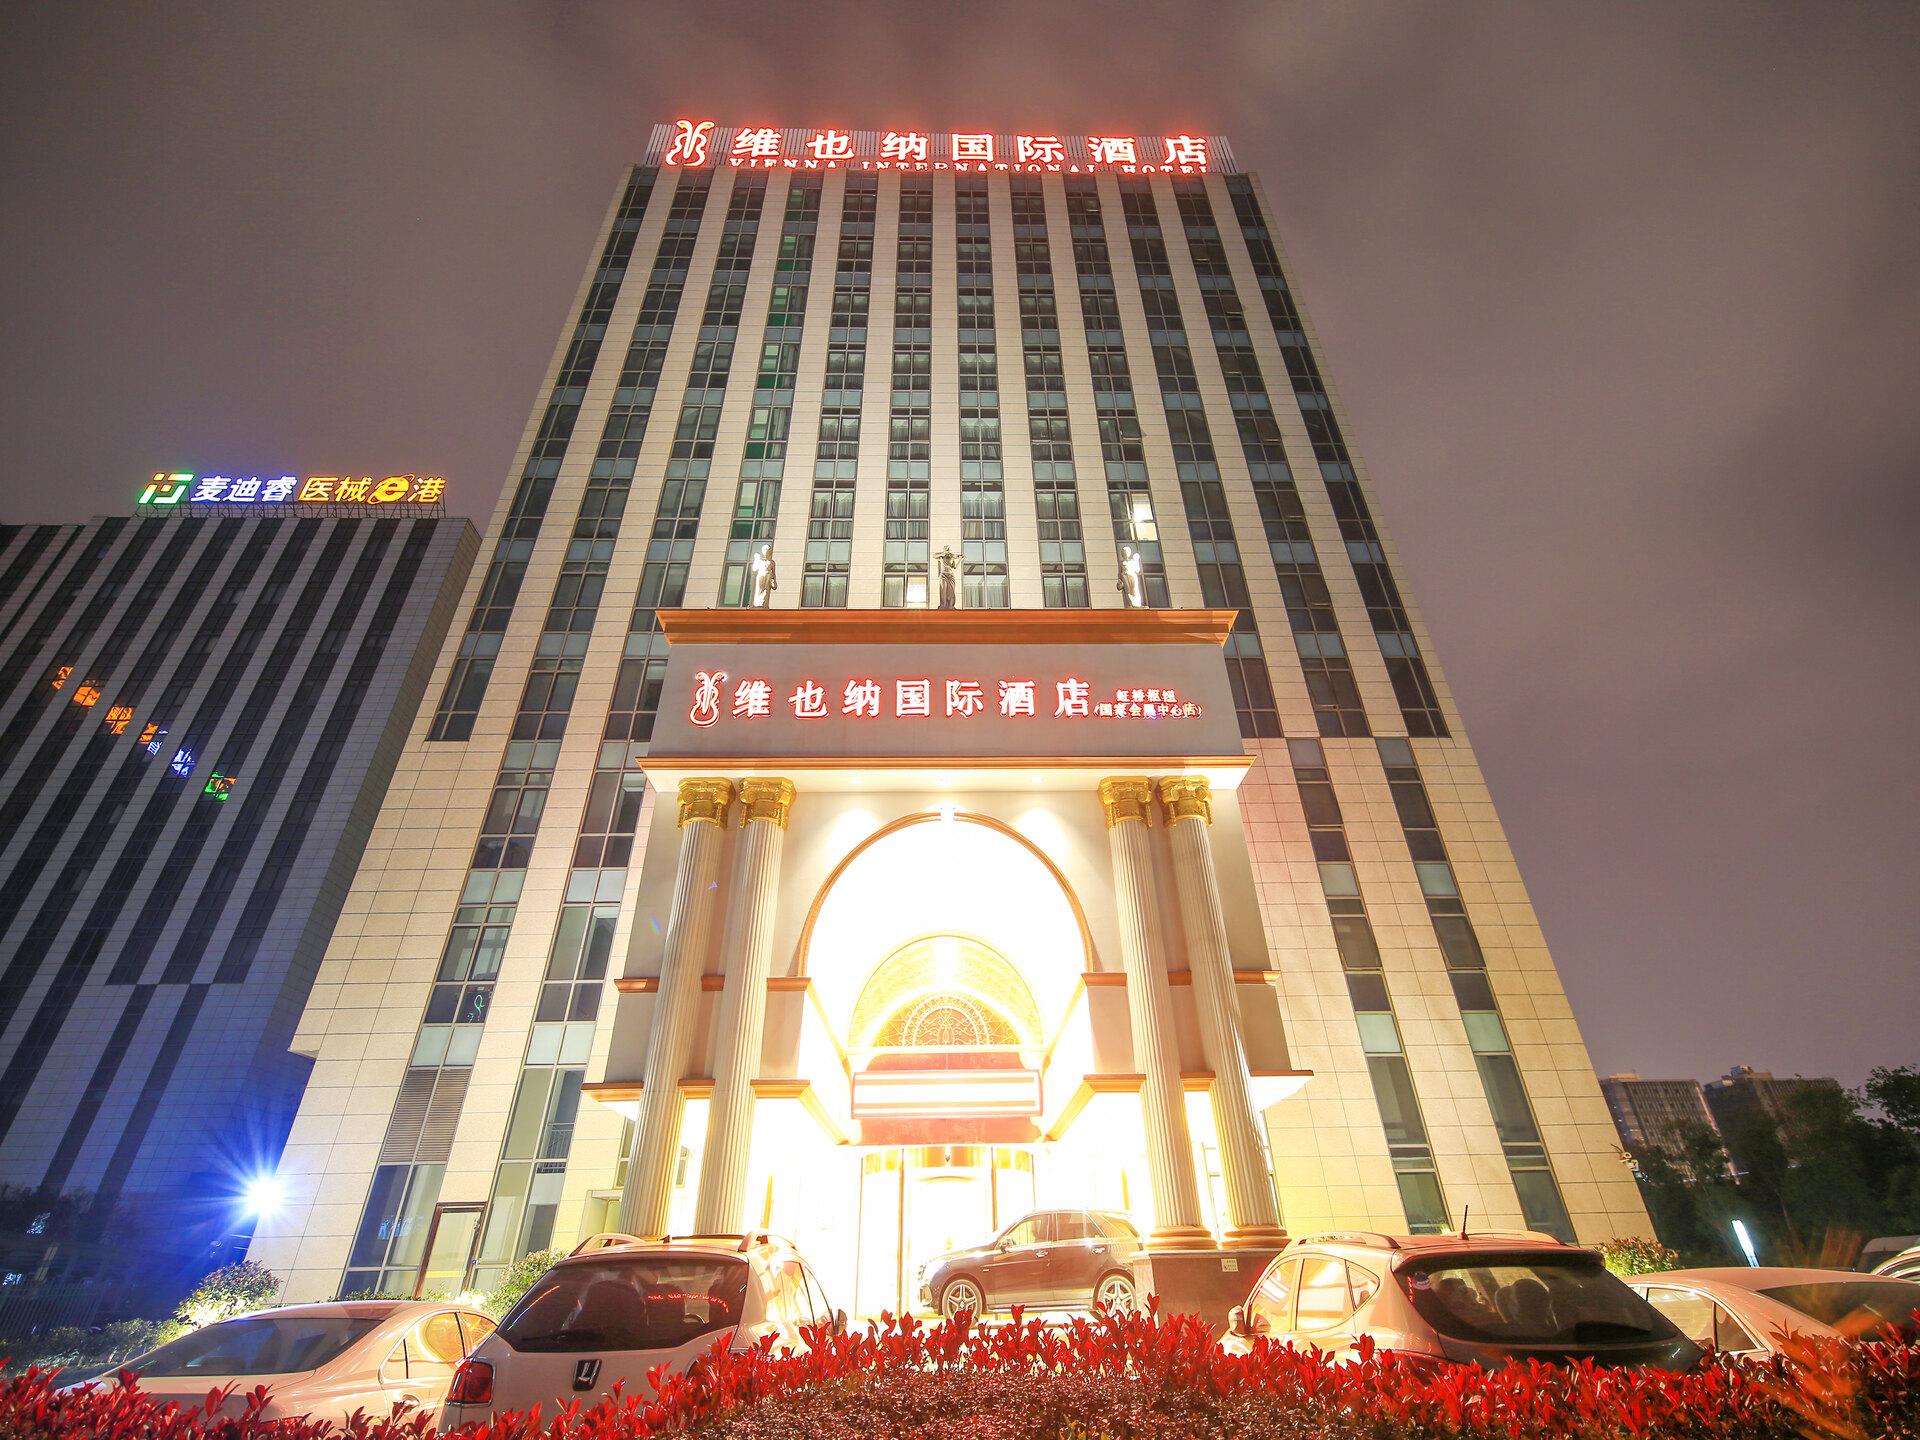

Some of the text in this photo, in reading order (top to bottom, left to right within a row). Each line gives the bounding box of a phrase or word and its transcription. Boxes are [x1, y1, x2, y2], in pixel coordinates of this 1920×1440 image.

[731, 127, 1208, 164] 维也纳国际酒店
[190, 475, 298, 502] 麦迪睿
[731, 677, 1091, 719] 维也纳国际酒店
